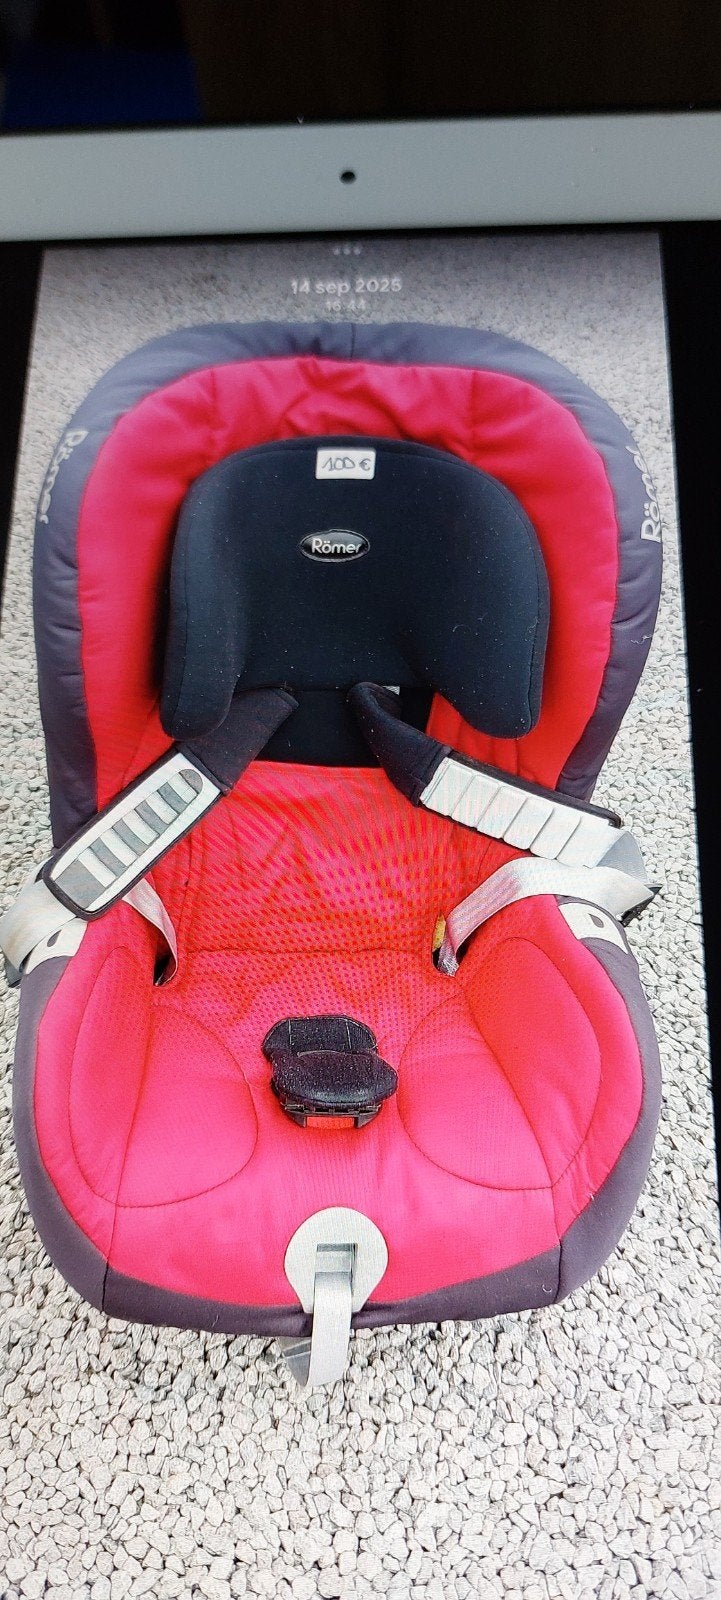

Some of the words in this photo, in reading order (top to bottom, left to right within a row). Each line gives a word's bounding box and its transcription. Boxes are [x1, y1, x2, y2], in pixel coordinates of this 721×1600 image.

[291, 278, 311, 294] 14
[315, 281, 350, 297] sep
[355, 277, 402, 293] 2025
[322, 456, 356, 472] 100
[358, 457, 372, 472] €
[311, 537, 362, 554] Römer
